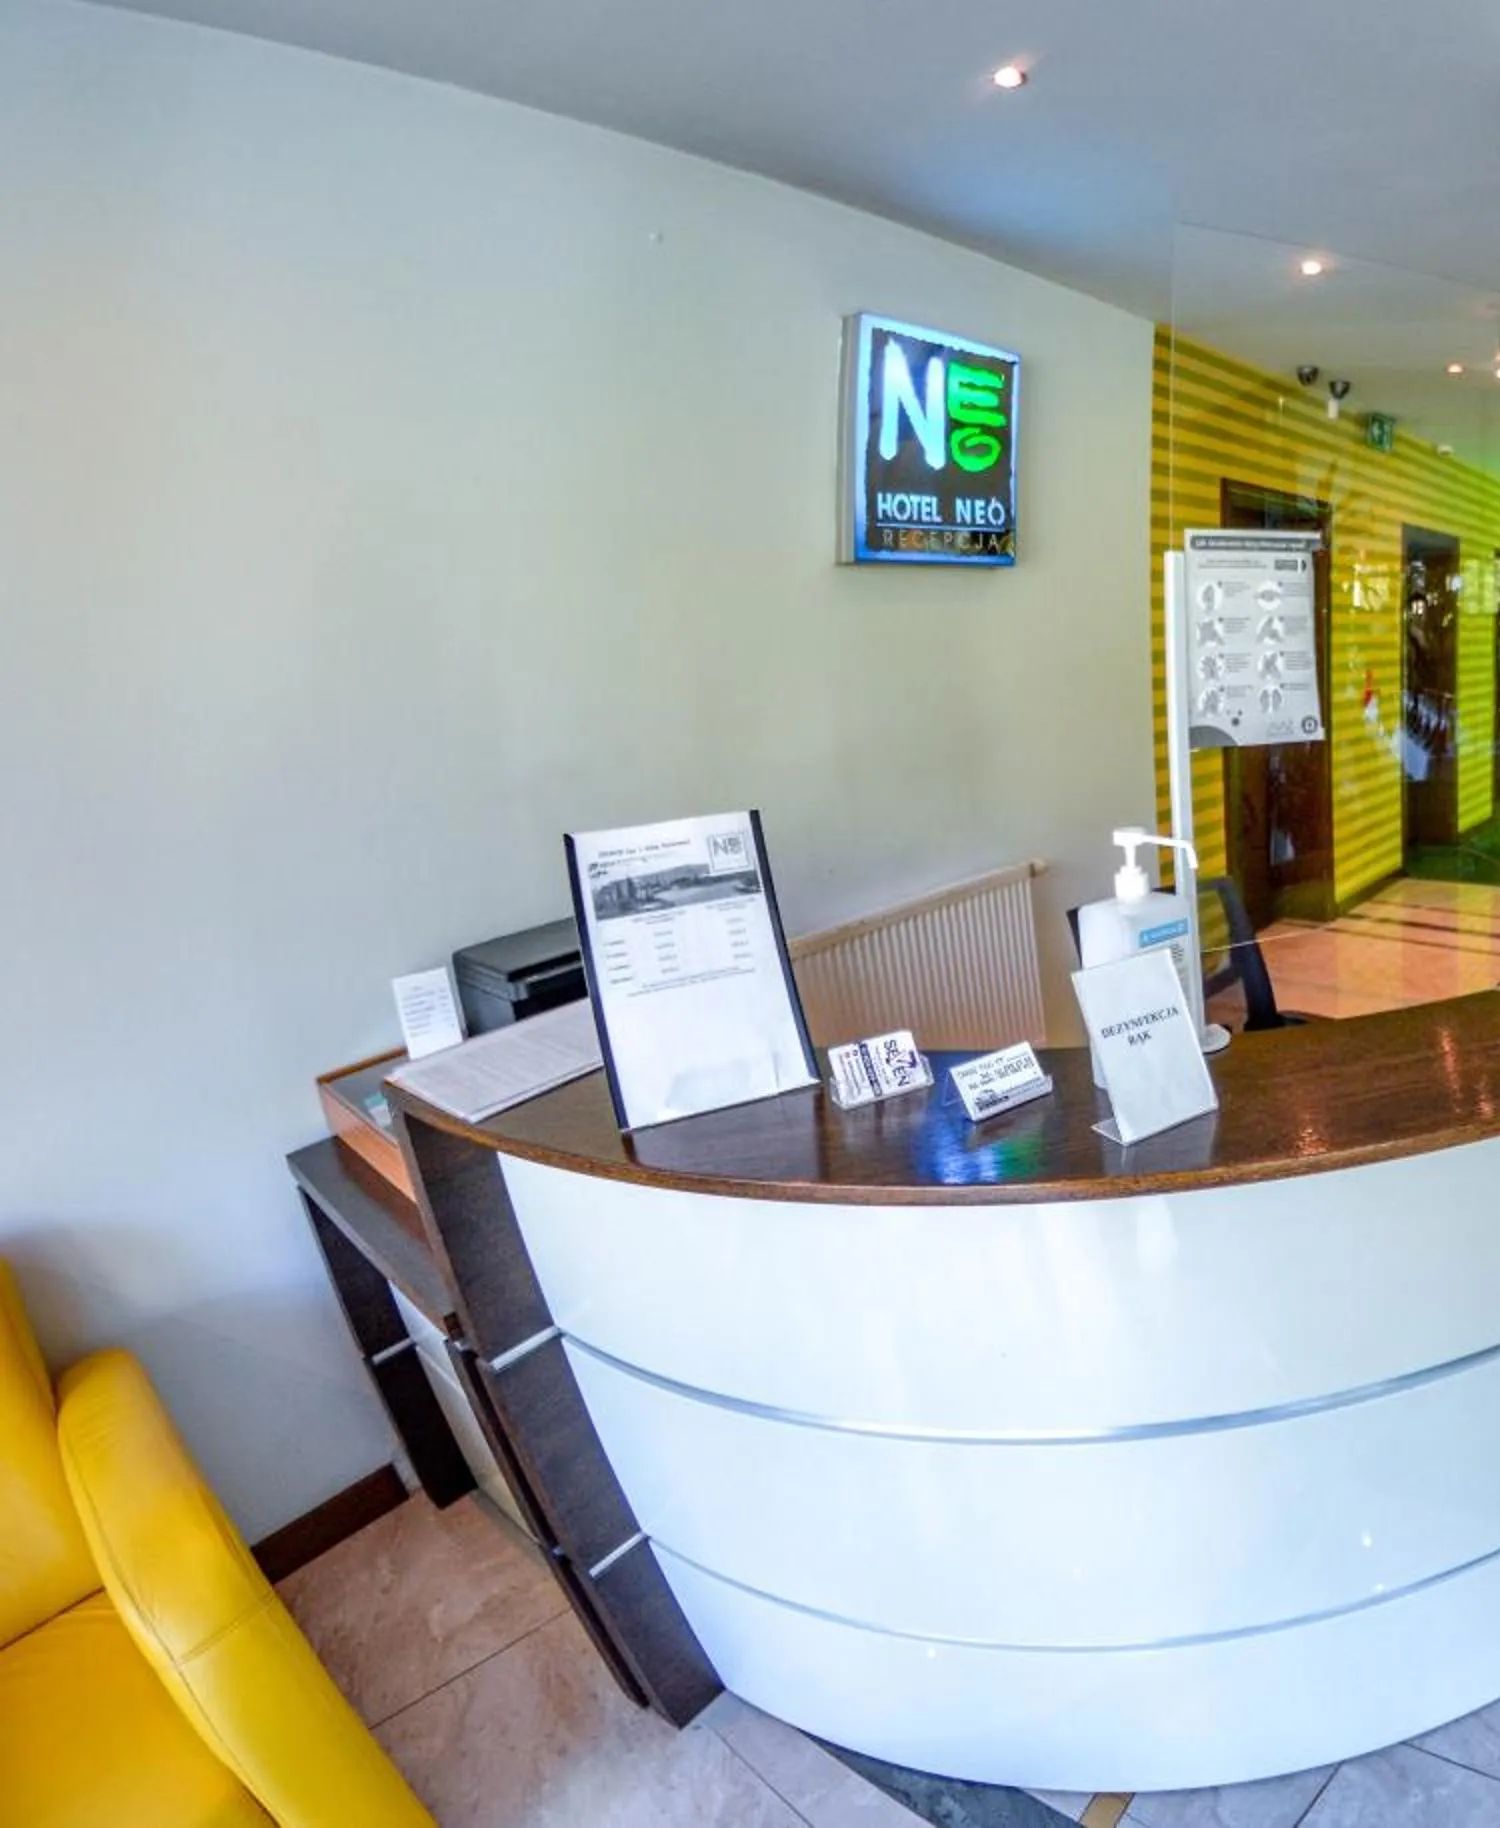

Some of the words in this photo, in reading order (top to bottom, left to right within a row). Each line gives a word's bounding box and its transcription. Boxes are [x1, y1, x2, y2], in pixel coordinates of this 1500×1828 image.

[877, 492, 942, 522] HOTEL
[882, 528, 1000, 551] RECEPCJA
[1101, 1005, 1179, 1039] DEZYNFEKCJA
